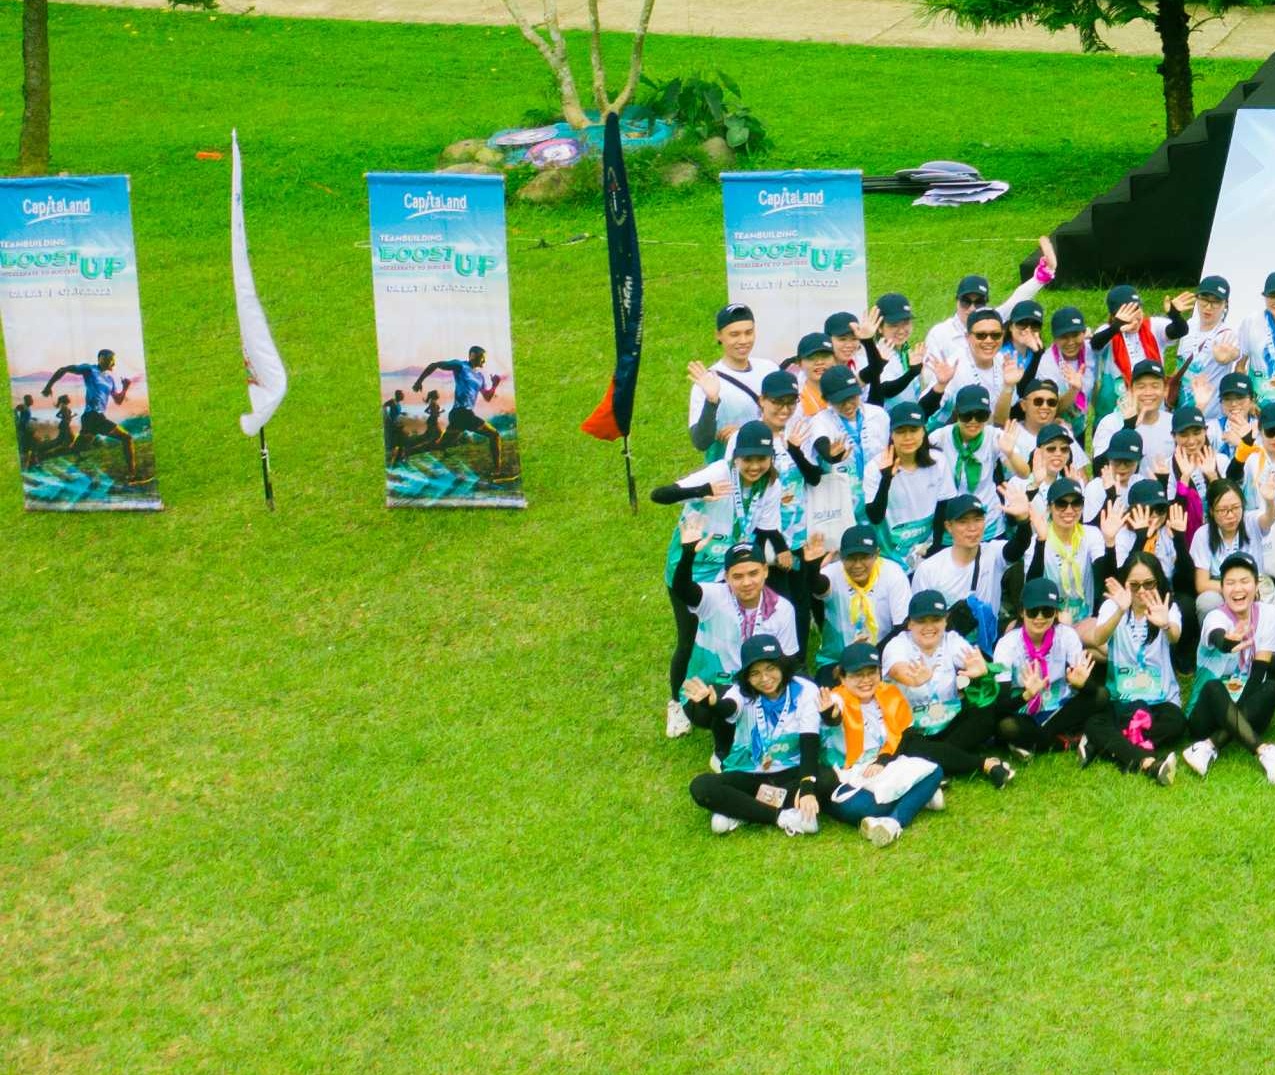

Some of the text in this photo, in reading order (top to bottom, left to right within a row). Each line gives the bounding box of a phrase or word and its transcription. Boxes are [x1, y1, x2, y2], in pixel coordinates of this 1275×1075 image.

[22, 195, 92, 218] CapitaLand
[403, 190, 468, 212] CapitaLand
[758, 187, 825, 208] CapitaLand
[378, 245, 454, 263] BOOST
[732, 241, 811, 260] BOOST
[811, 247, 857, 272] UP
[80, 256, 127, 280] UP
[455, 252, 498, 277] UP
